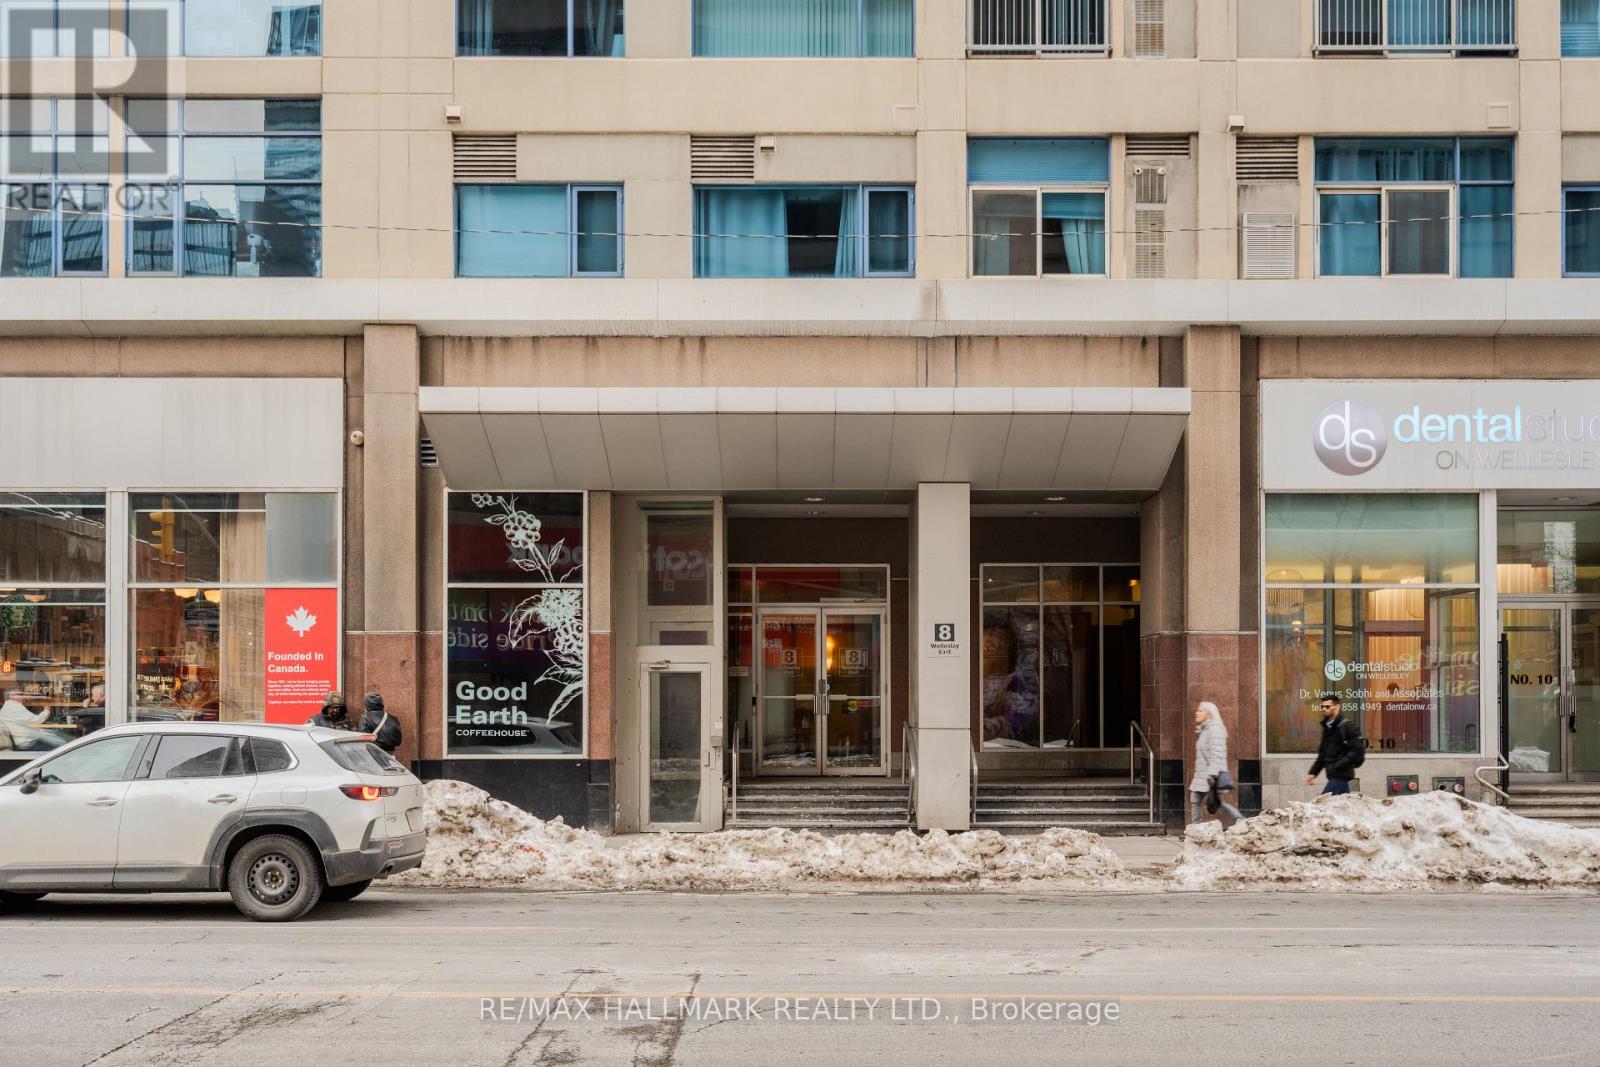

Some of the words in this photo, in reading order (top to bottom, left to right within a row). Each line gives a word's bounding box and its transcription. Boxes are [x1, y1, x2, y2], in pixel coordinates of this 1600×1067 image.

[1435, 449, 1470, 470] ON
[939, 624, 952, 641] 8
[268, 651, 312, 661] Founded
[268, 663, 309, 673] Canada.
[1347, 660, 1420, 672] dentalstudio
[1368, 672, 1410, 680] WELLESLEY
[1510, 674, 1533, 685] NO.
[1537, 674, 1553, 685] 10
[456, 680, 528, 701] Good
[1299, 688, 1312, 699] Dr.
[1345, 688, 1372, 699] Sobhi
[1375, 690, 1390, 699] and
[1341, 702, 1358, 711] 858
[1360, 702, 1382, 711] 4949
[456, 705, 528, 725] Earth
[456, 729, 528, 737] COFFEEHOUSE
[1379, 738, 1396, 750] 10
